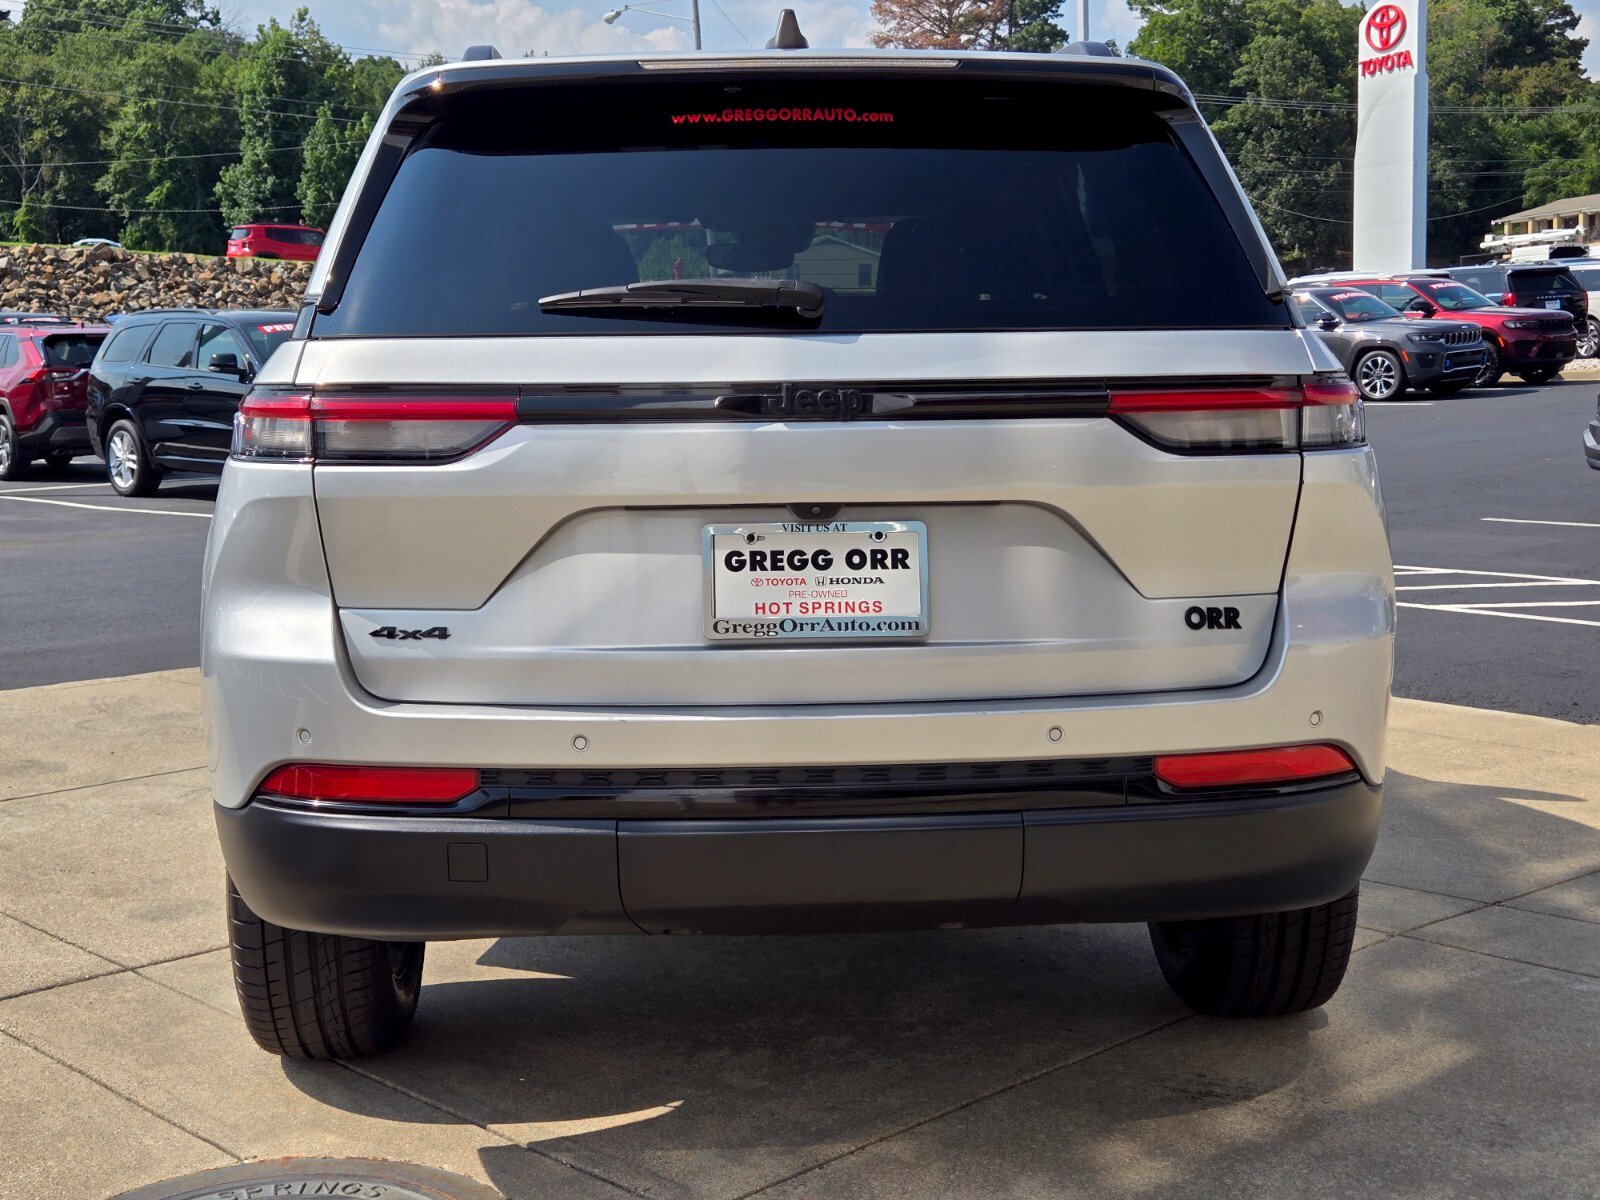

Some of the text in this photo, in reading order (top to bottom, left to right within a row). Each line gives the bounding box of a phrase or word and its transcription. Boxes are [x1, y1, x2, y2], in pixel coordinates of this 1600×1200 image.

[1359, 50, 1414, 77] TOYOTA
[671, 107, 894, 124] www.GREGGORRAUTO.com
[767, 383, 862, 420] Jeep
[782, 523, 848, 532] VISIT US AT
[724, 548, 911, 572] GREGG ORR
[765, 578, 807, 586] TOYOTA
[828, 576, 885, 585] HONDA
[788, 589, 848, 598] PRE-OWNED
[754, 600, 883, 615] HOT SPRINGS
[1184, 605, 1242, 630] ORR
[368, 626, 452, 640] 4x4
[712, 617, 920, 637] GreggOrrAuto.com
[216, 1181, 388, 1200] SPRINGS
